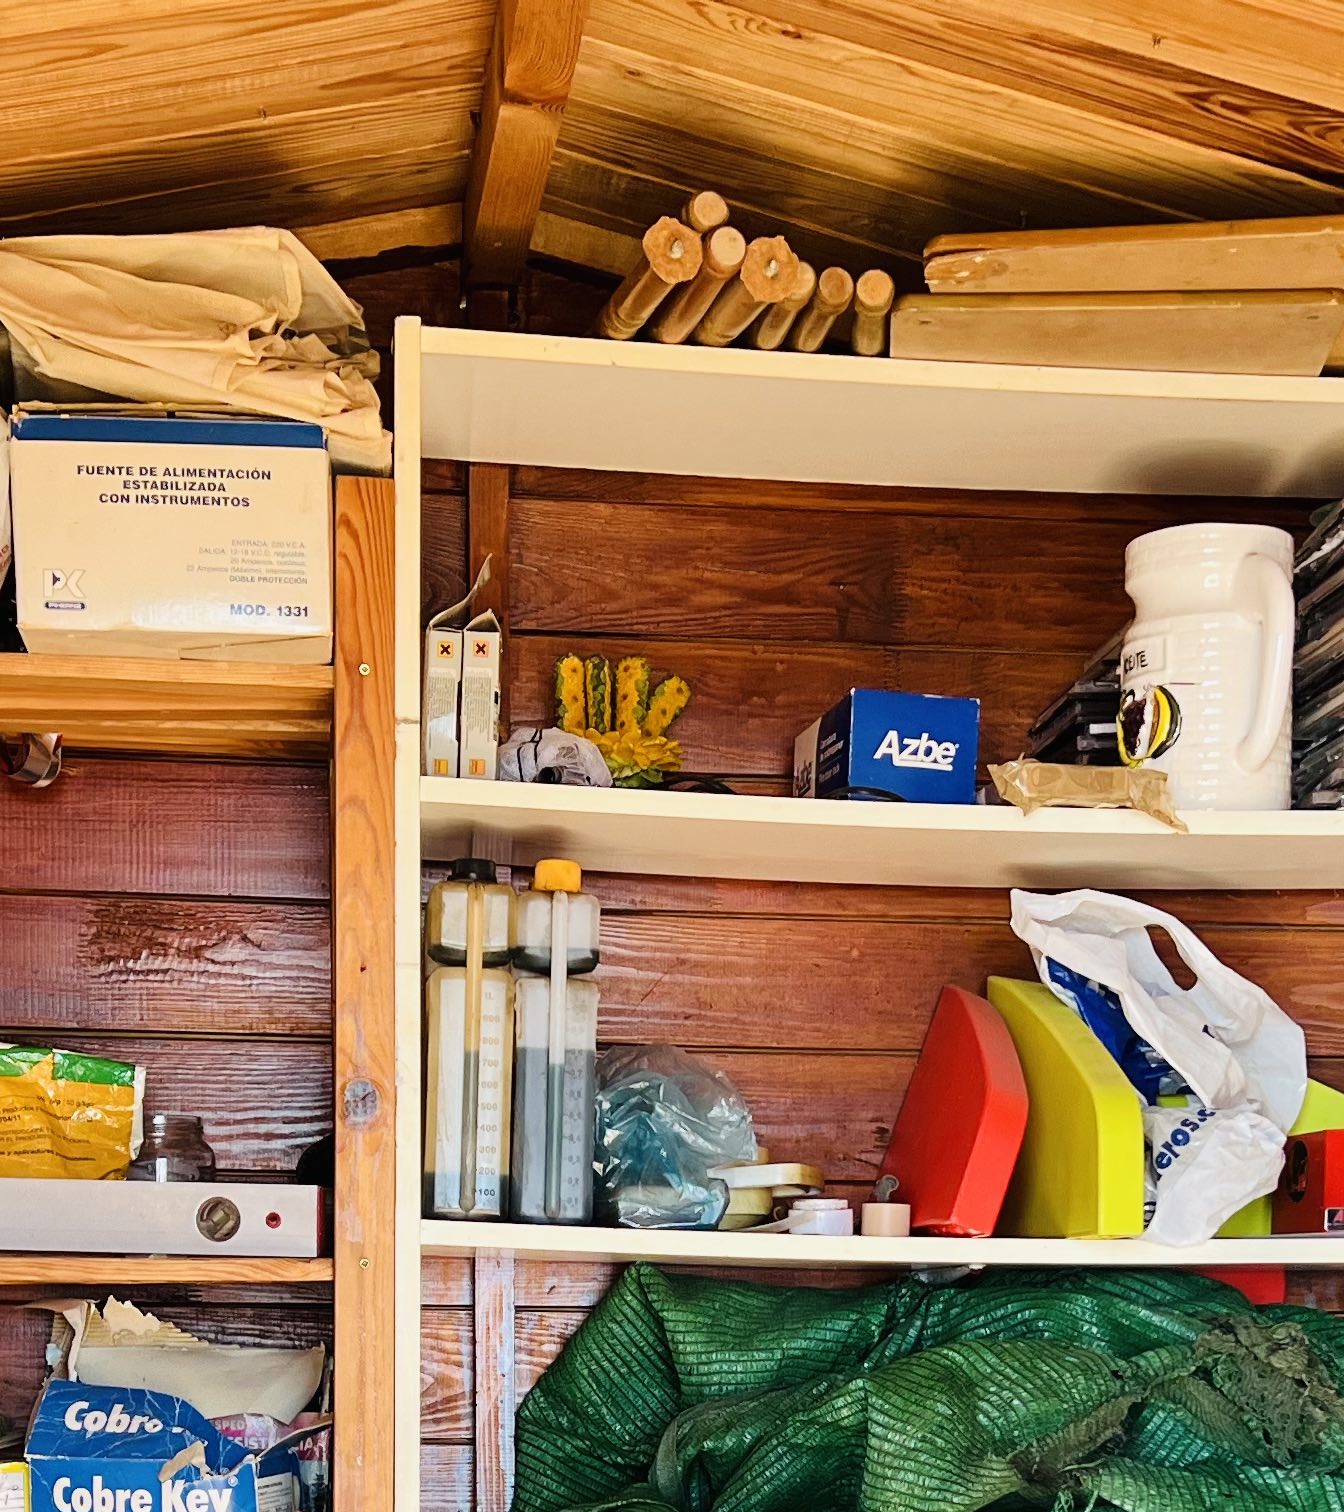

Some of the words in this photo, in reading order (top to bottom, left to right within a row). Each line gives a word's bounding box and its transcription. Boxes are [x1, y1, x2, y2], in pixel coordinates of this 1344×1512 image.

[76, 464, 134, 476] FUENTE
[138, 465, 158, 477] DE
[162, 466, 272, 480] ALIMENTACIÓN
[122, 480, 227, 493] ESTABILIZADA
[98, 493, 130, 504] CON
[135, 494, 251, 508] INSTRUMENTOS
[229, 603, 271, 617] MOD.
[276, 605, 309, 617] 1331
[872, 729, 957, 772] Azbe
[479, 1124, 498, 1133] 400
[479, 1145, 497, 1155] 300
[478, 1167, 496, 1176] 200
[478, 1188, 496, 1197] 100
